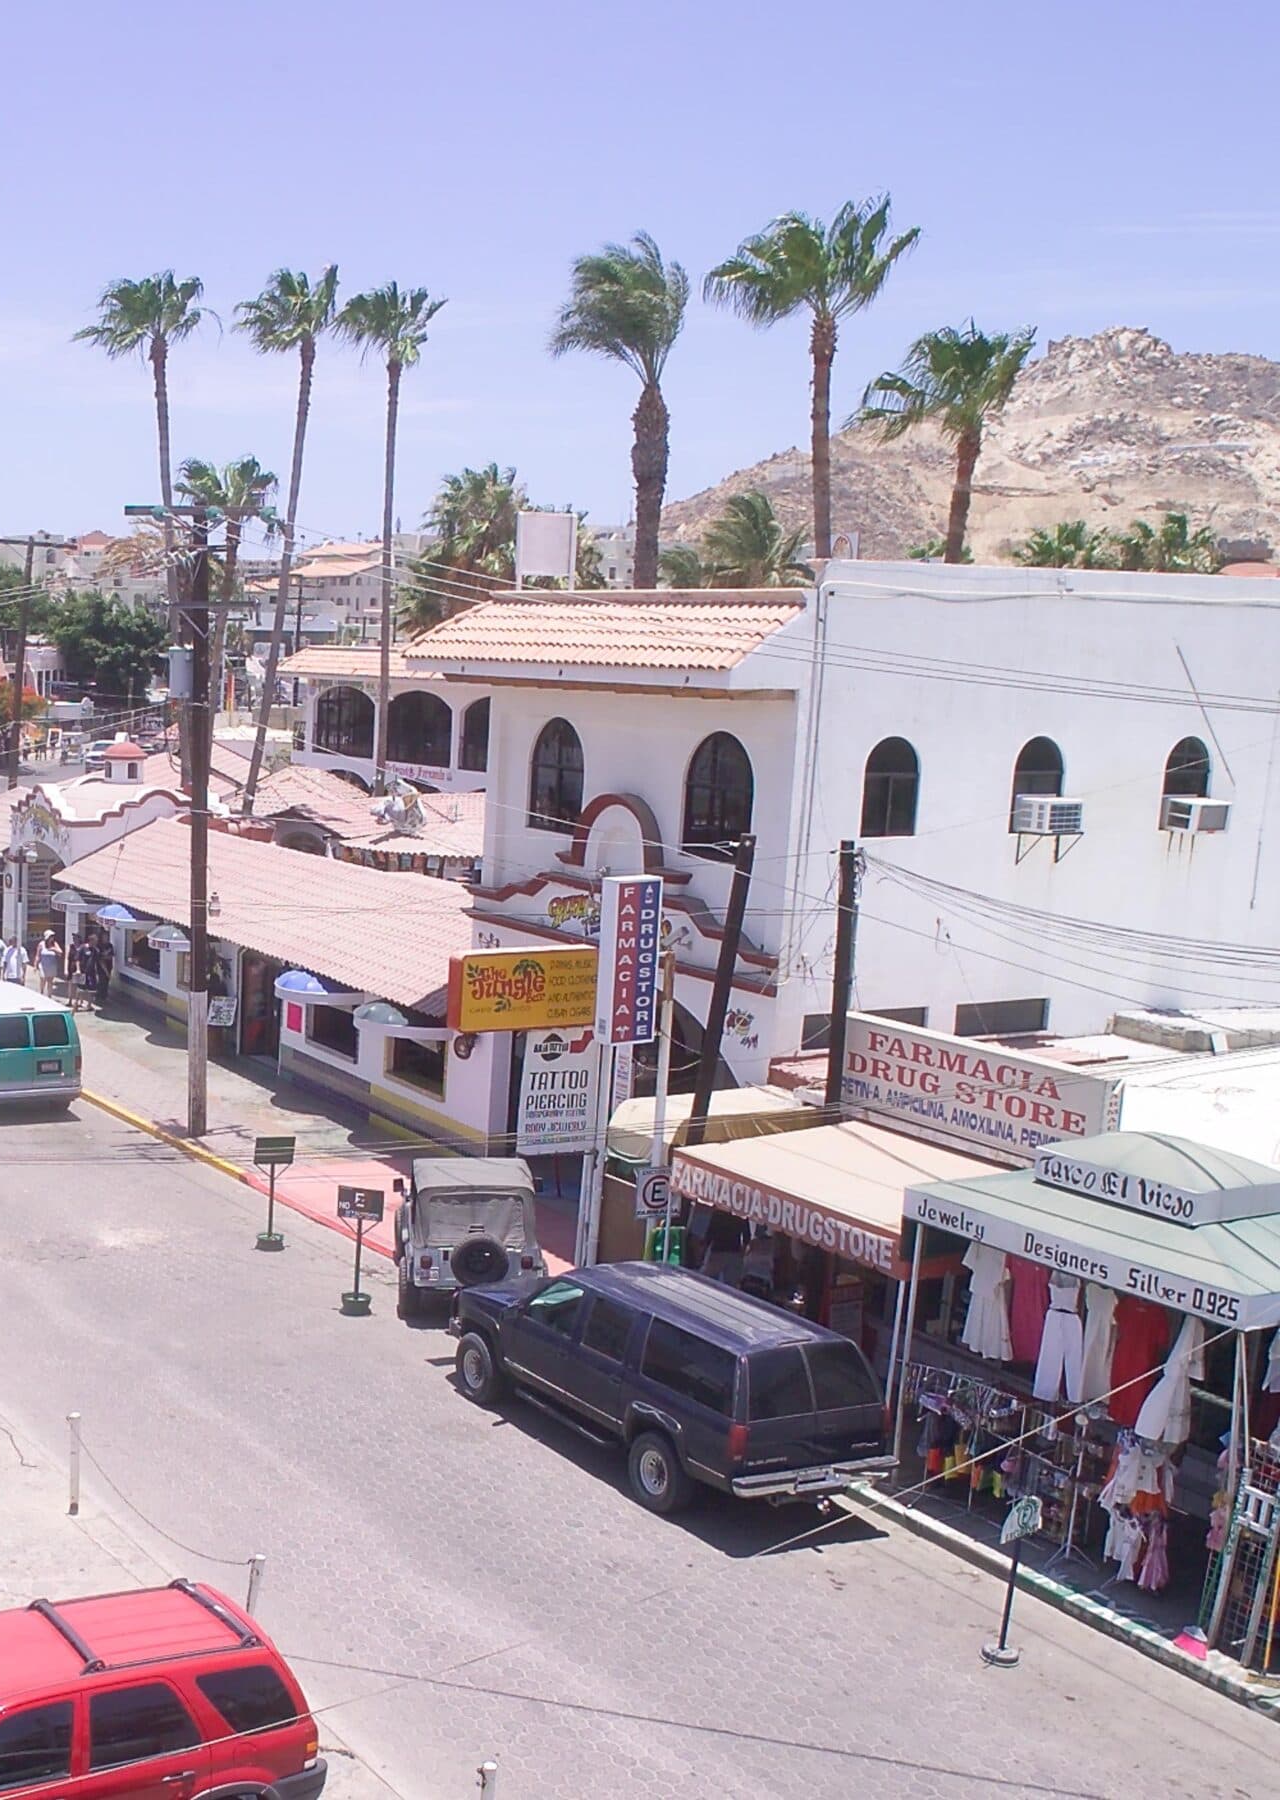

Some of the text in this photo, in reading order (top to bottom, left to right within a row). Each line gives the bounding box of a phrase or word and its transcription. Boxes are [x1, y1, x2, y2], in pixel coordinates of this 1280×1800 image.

[616, 886, 635, 1016] FARMACIA
[472, 970, 546, 1000] Jungle
[480, 966, 506, 981] The
[635, 908, 656, 1036] DRUGSTORE
[529, 1069, 589, 1091] TATTOO
[867, 1031, 1062, 1100] FARMACIA
[526, 1092, 587, 1111] PIERCING
[847, 1051, 1087, 1136] DRUG STORE
[950, 1112, 1018, 1146] AMOXILINA,
[651, 1181, 666, 1202] E
[1103, 1170, 1128, 1198] El
[354, 1192, 365, 1208] E
[917, 1199, 986, 1241] Jewelry
[1023, 1232, 1109, 1280] Designers
